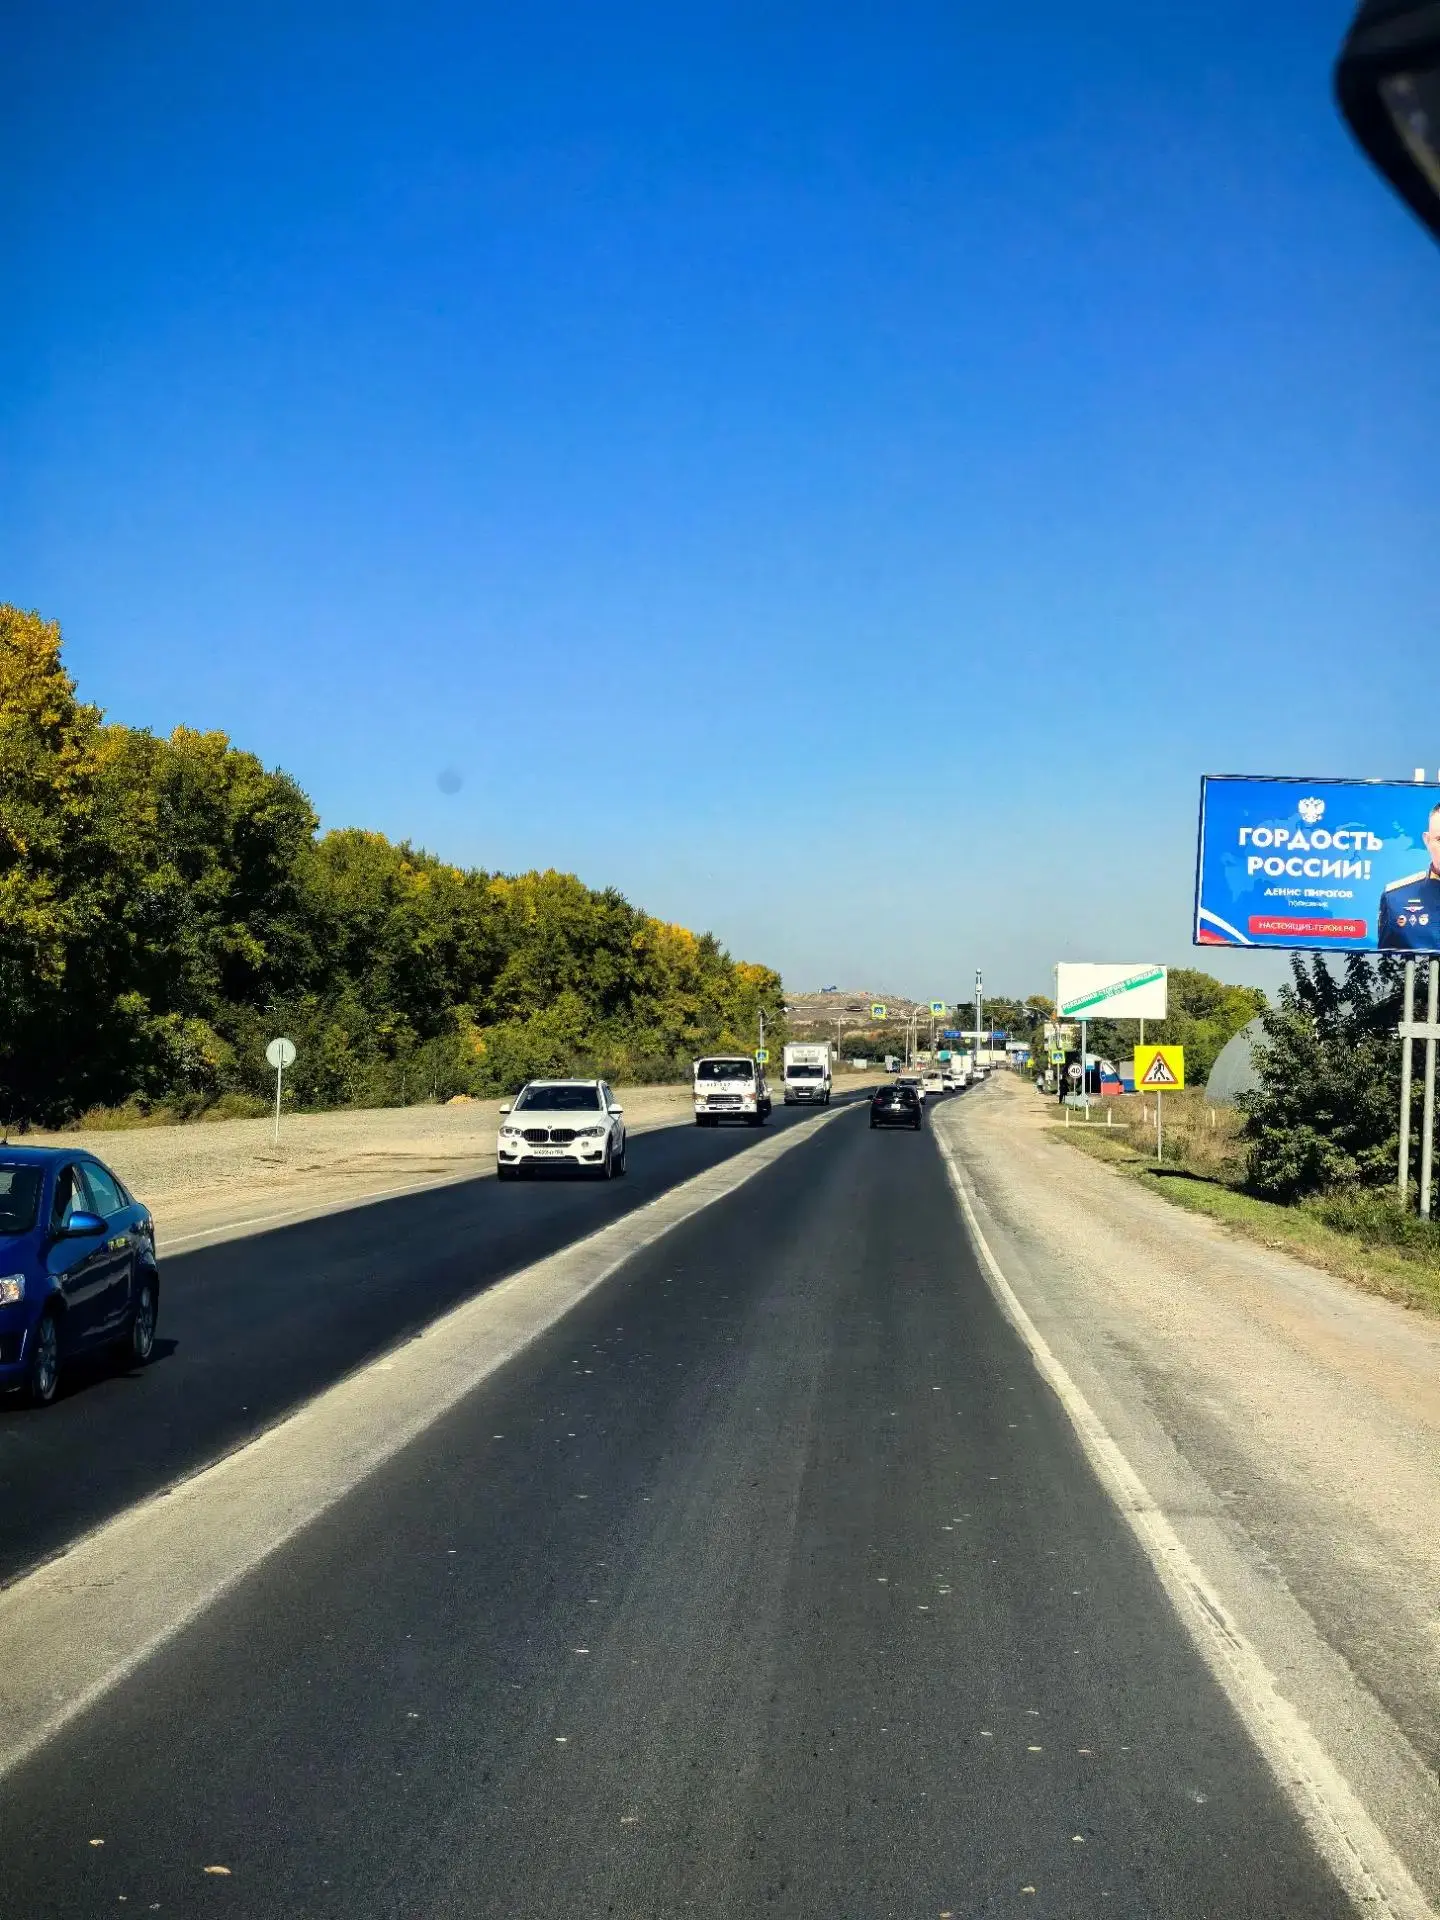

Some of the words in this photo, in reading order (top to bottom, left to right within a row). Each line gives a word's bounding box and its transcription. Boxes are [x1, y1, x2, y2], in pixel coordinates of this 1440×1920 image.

[1239, 827, 1383, 851] ГОРДОСТЬ
[1247, 856, 1372, 880] РОССИИ!
[1264, 888, 1302, 896] ДЕНИС
